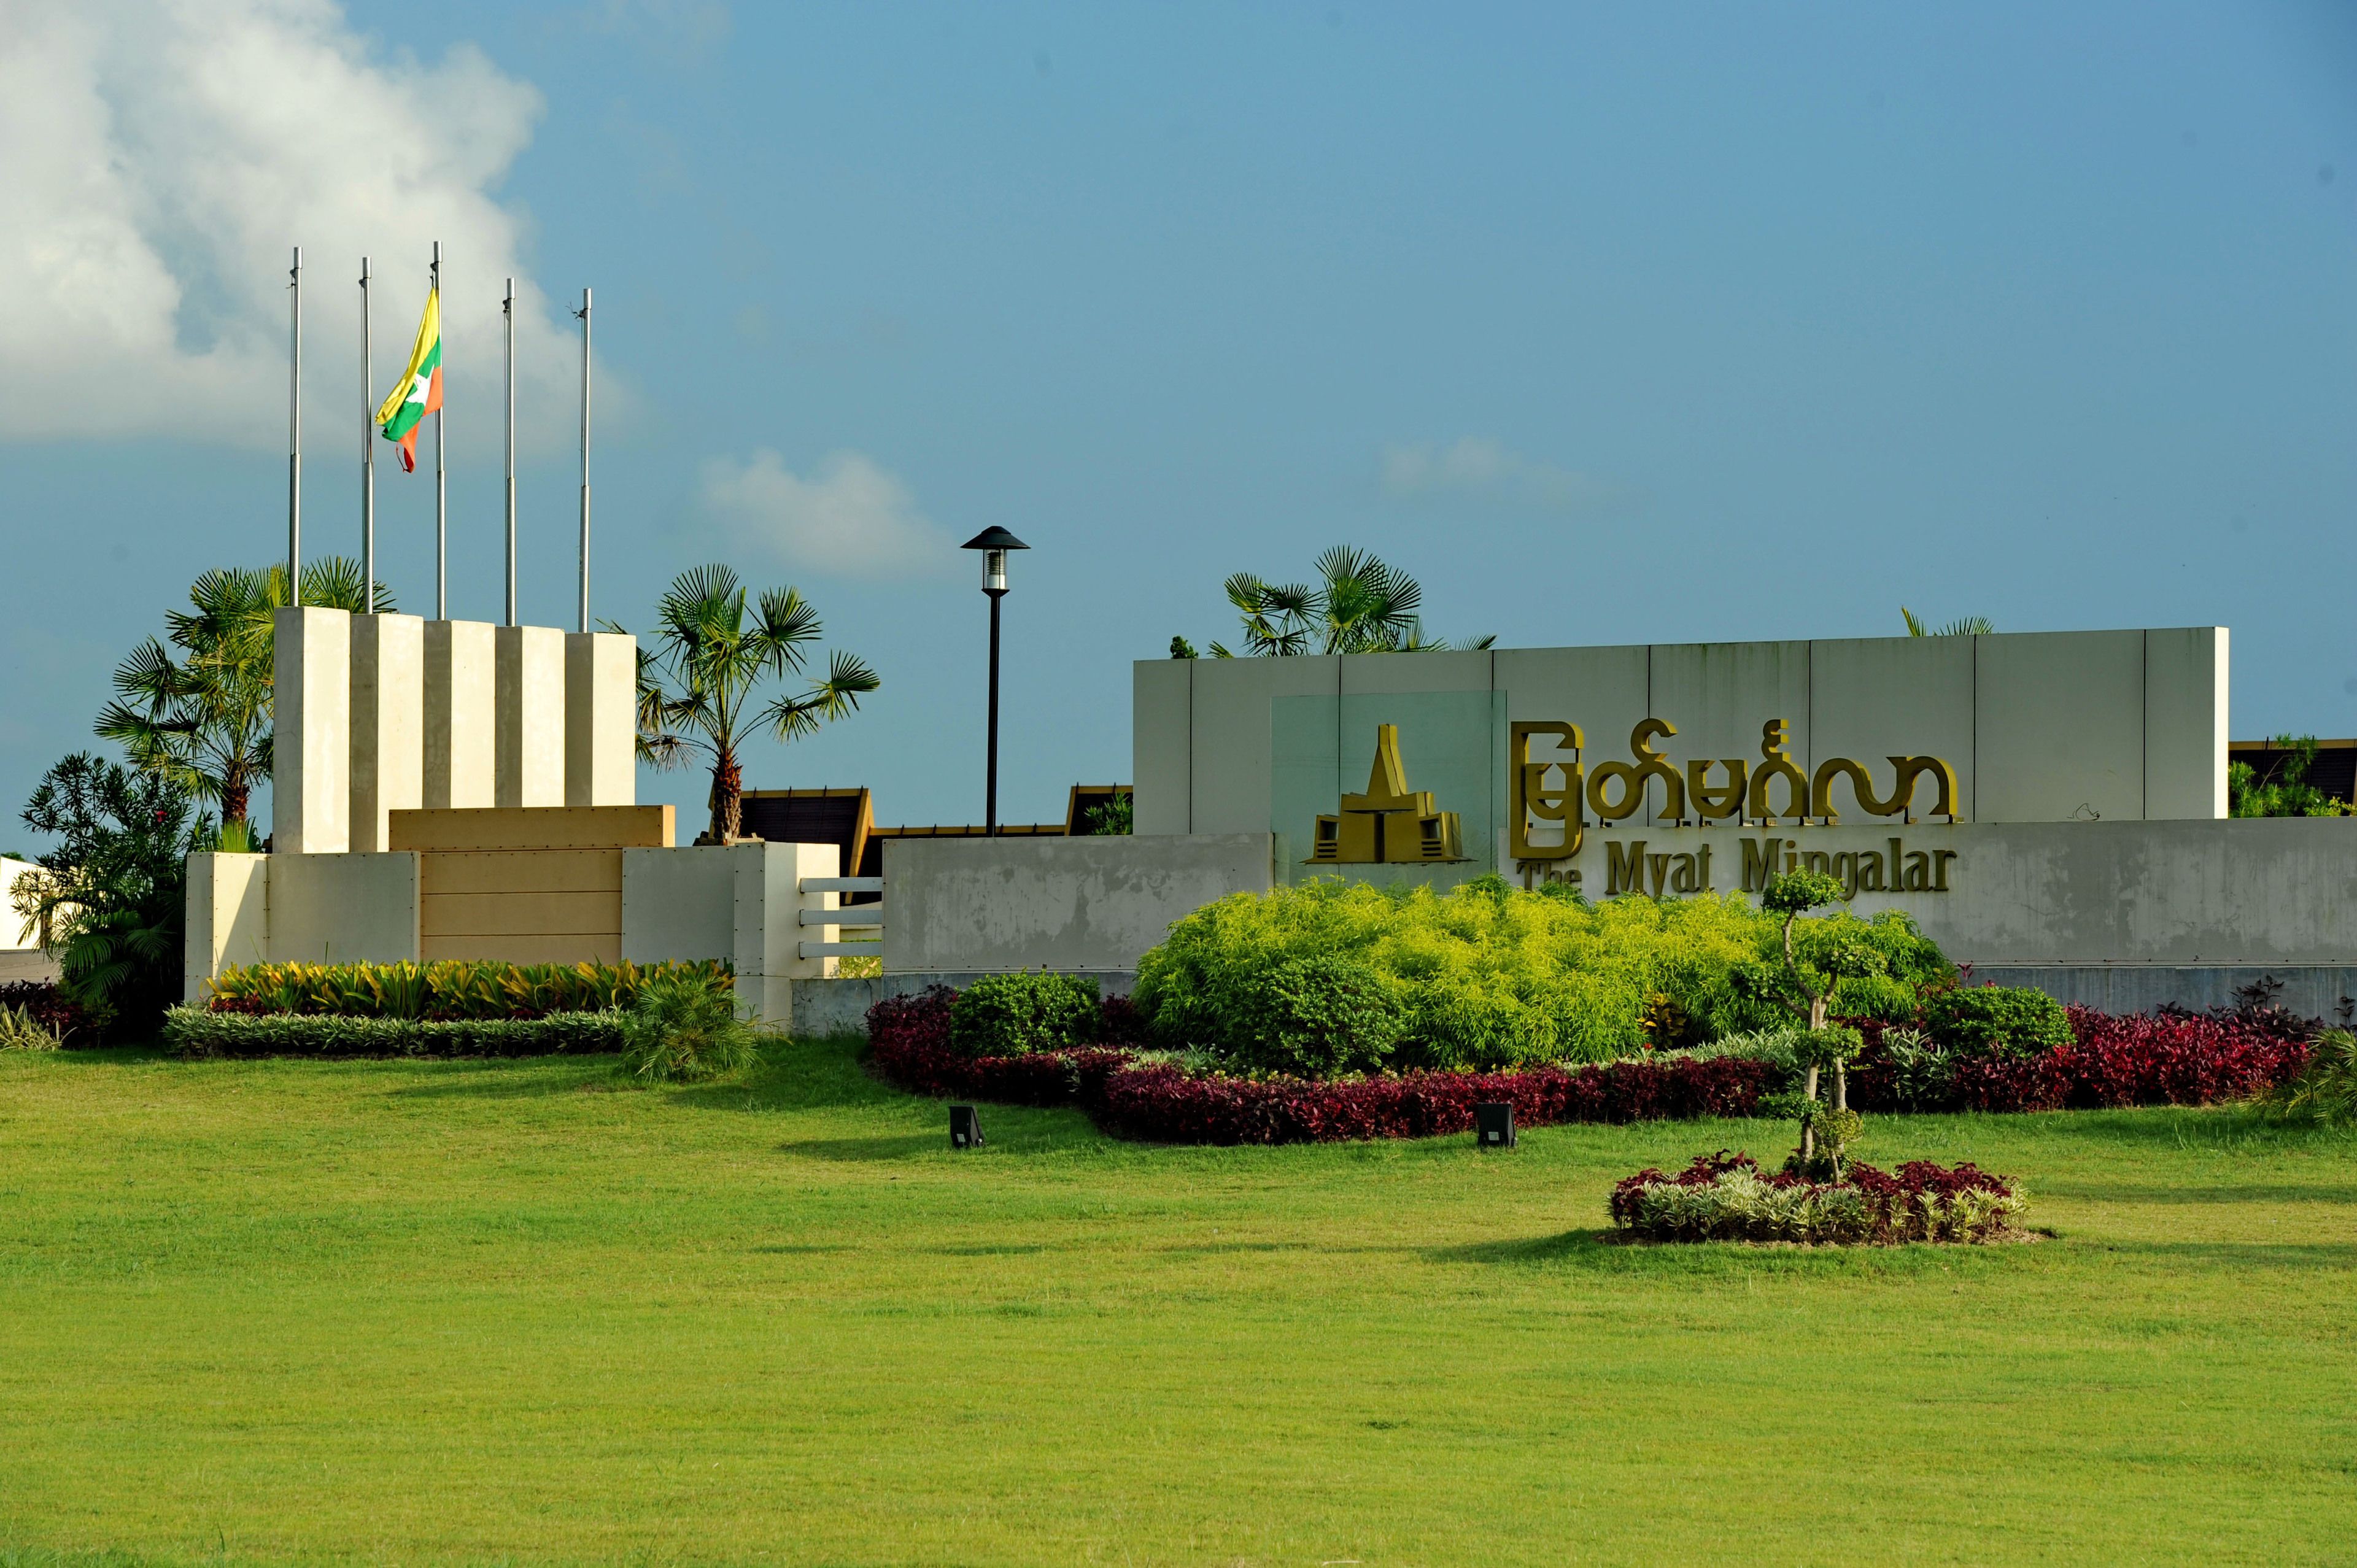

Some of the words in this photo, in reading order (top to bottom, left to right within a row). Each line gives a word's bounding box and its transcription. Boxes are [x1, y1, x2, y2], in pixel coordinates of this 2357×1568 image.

[1516, 860, 1582, 894] The
[1604, 840, 1715, 902] Myat
[1739, 837, 1958, 901] Mingalar
